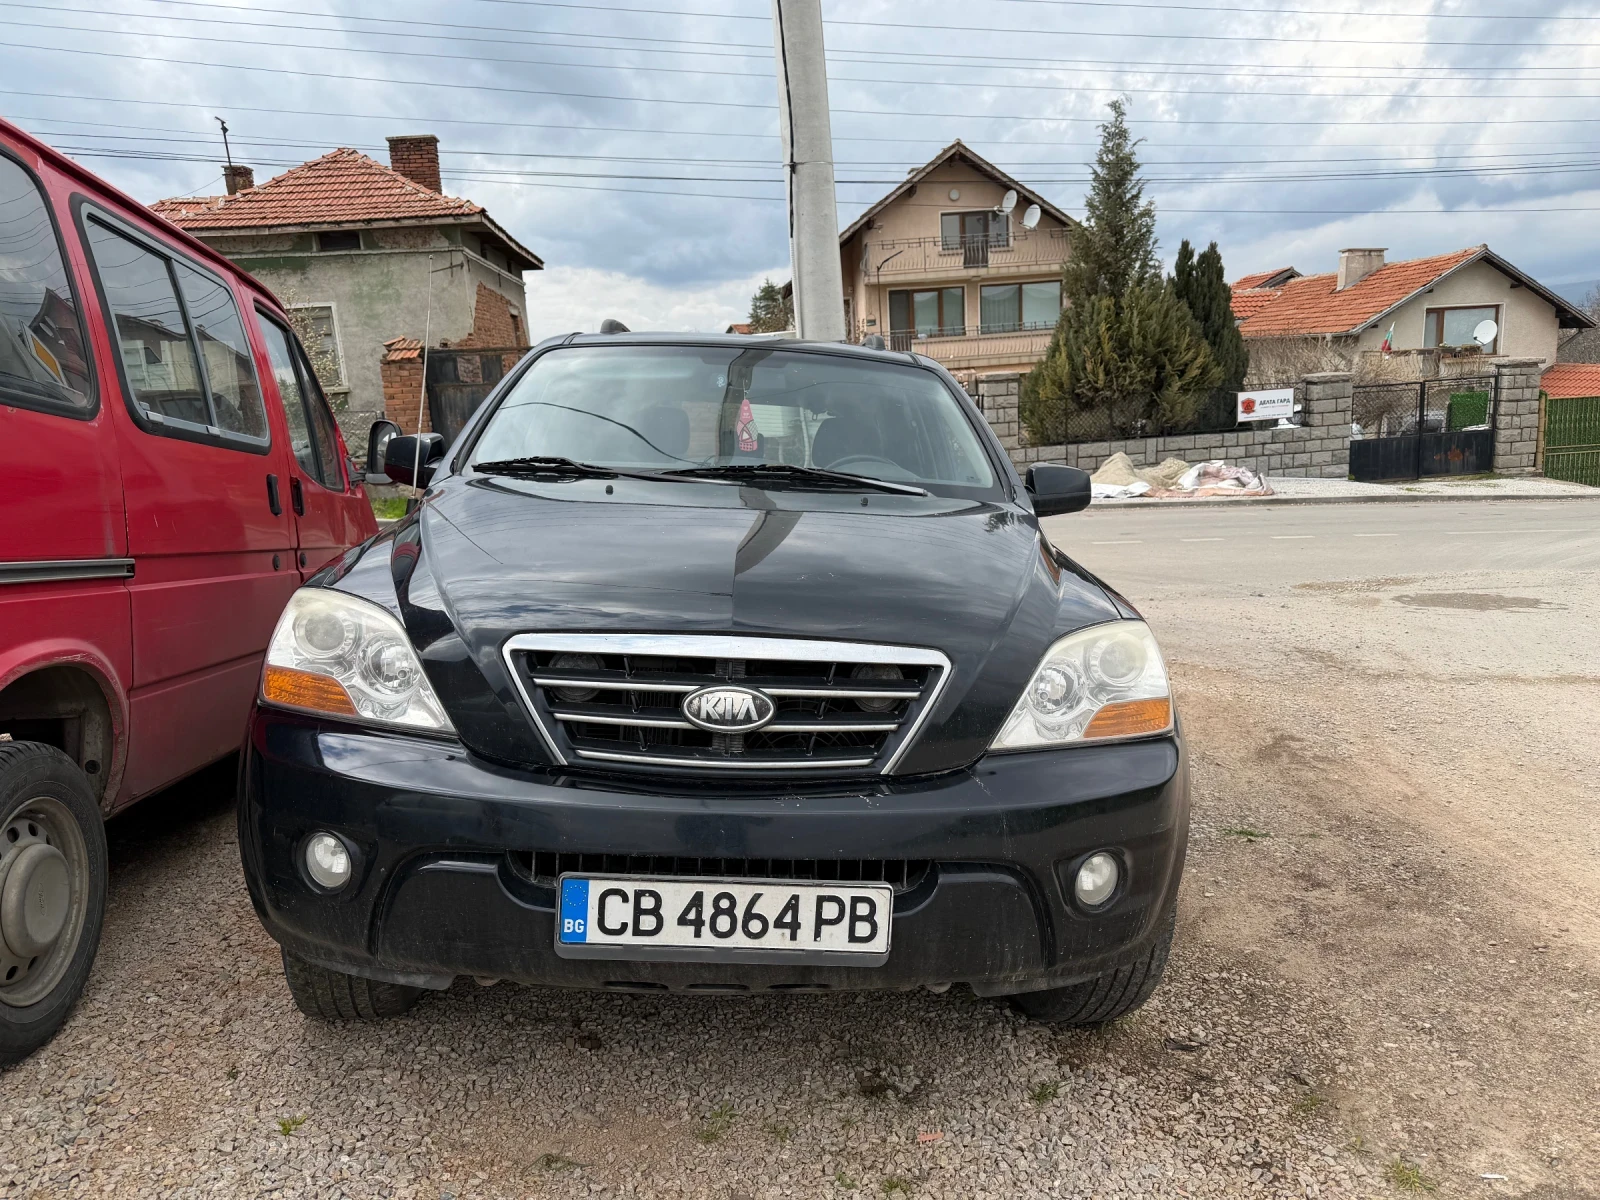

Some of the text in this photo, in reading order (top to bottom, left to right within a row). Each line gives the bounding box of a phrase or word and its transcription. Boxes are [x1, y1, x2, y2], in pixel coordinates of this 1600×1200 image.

[699, 694, 759, 721] KIA
[563, 918, 585, 933] BG
[597, 888, 879, 944] CB 4864 PB
